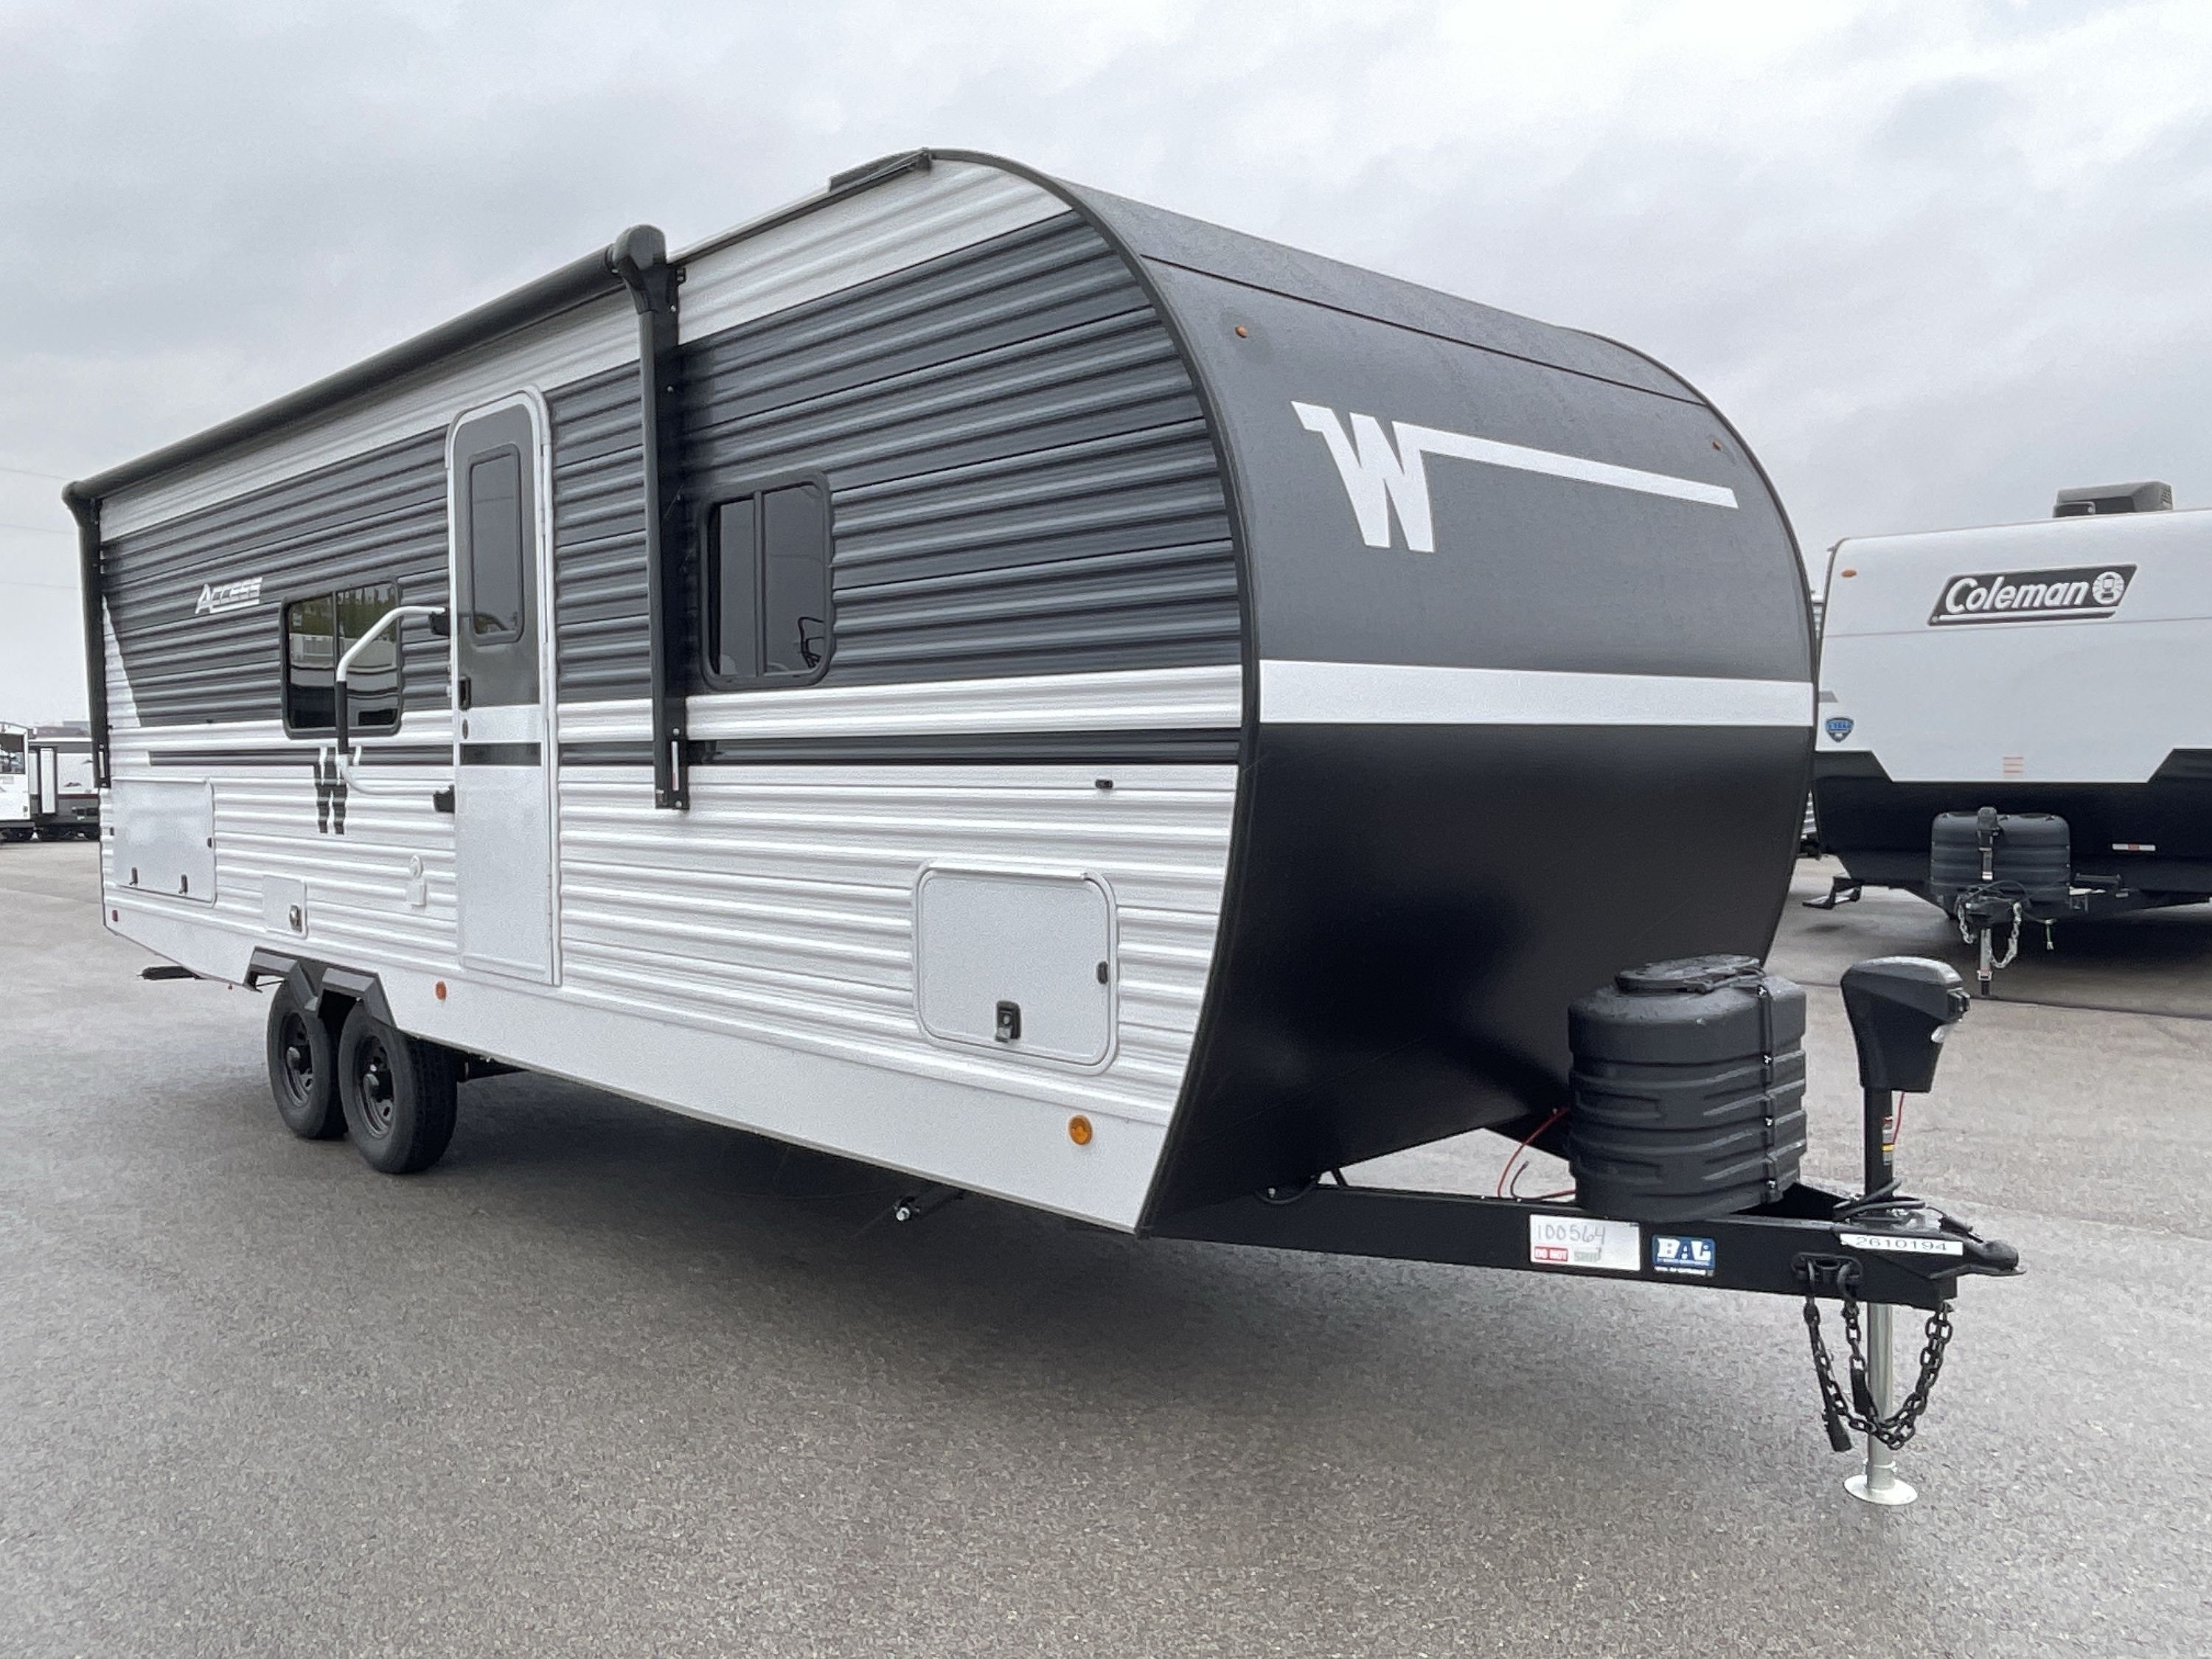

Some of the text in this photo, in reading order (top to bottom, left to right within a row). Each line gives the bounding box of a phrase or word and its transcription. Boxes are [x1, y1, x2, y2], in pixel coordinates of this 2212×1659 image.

[195, 577, 262, 614] ACCESS
[1945, 576, 2090, 614] Coleman
[1537, 1224, 1606, 1245] 100564
[1855, 1237, 1947, 1251] 2610194
